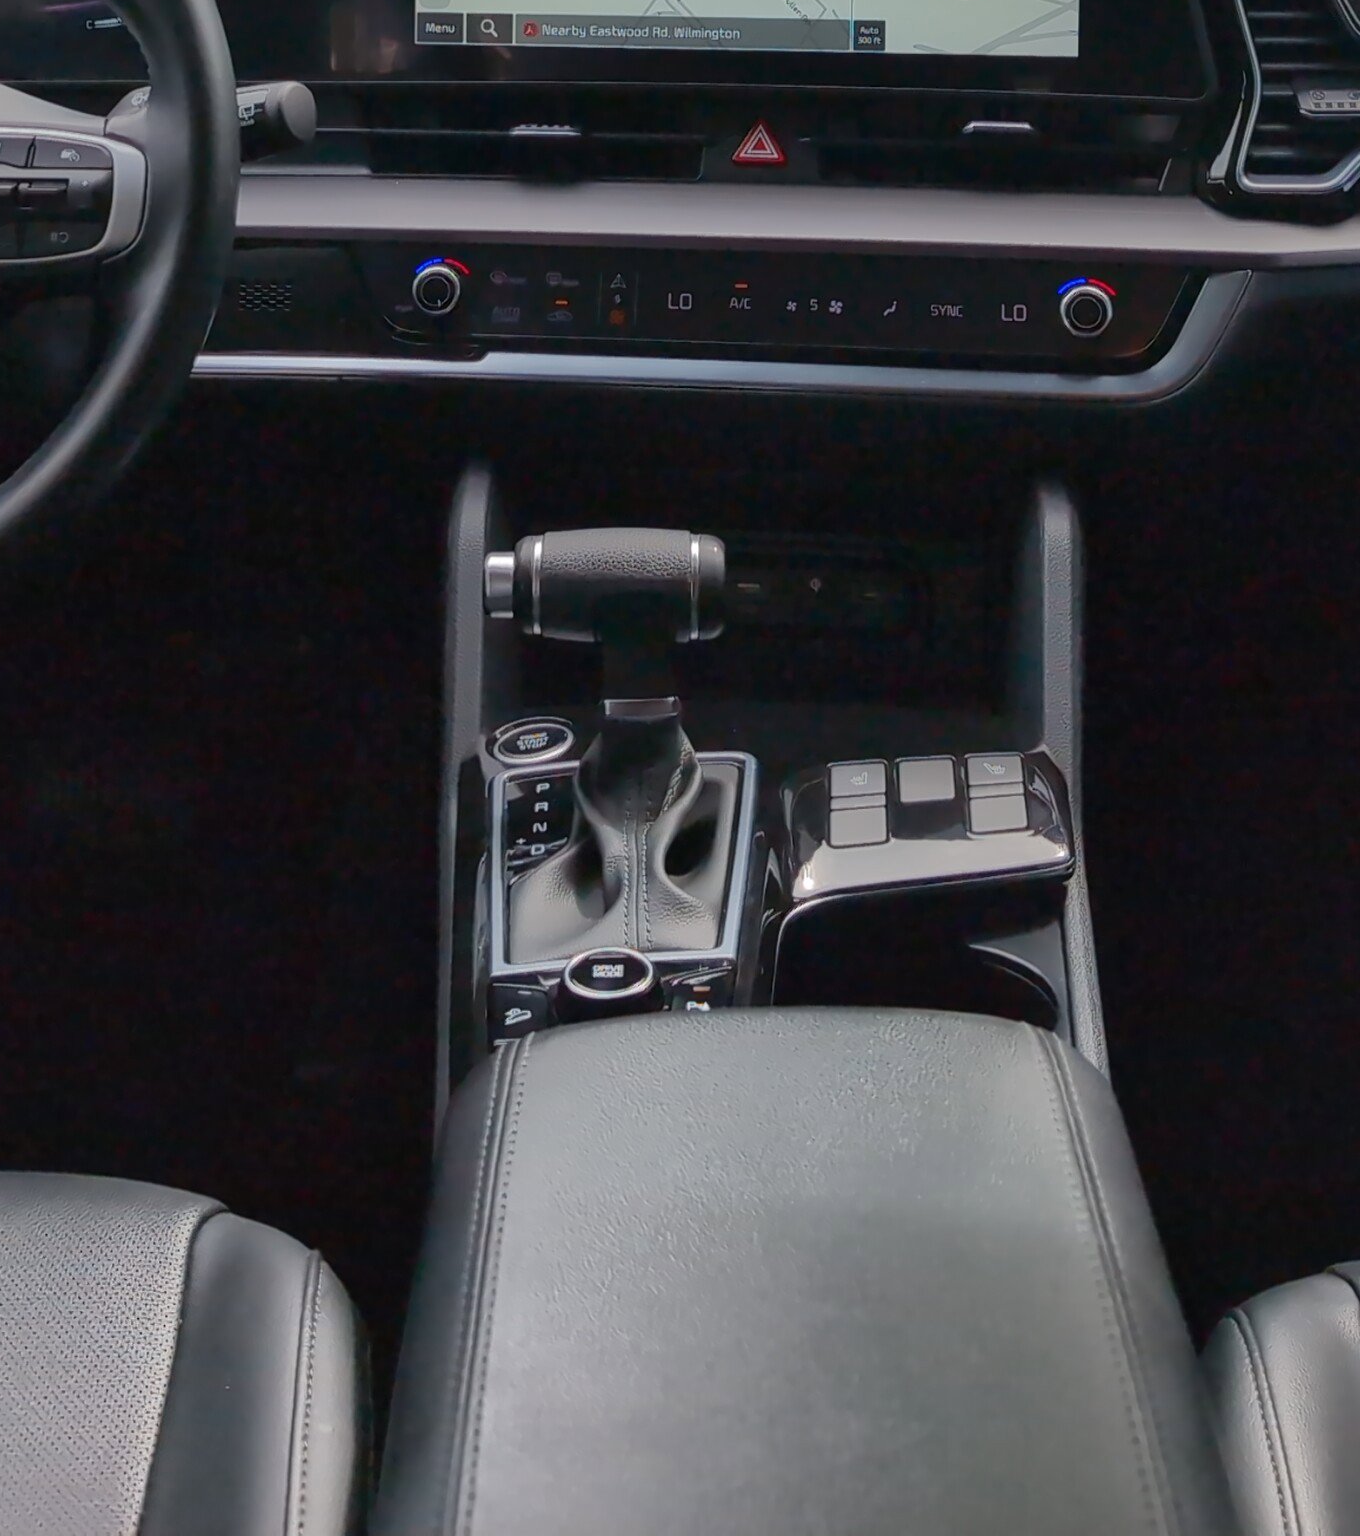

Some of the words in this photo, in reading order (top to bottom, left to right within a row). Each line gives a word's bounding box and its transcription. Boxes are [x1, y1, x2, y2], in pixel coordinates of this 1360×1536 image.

[425, 22, 455, 34] Menu
[542, 23, 586, 38] Nearby
[590, 25, 649, 38] Eastwood
[674, 27, 741, 41] Wilmington
[859, 26, 879, 35] Auto
[667, 293, 693, 310] LO
[729, 297, 752, 310] A/C
[930, 304, 964, 318] SYNC
[1001, 305, 1027, 322] LO
[536, 782, 550, 794] P
[533, 821, 547, 833] N
[530, 843, 545, 856] D
